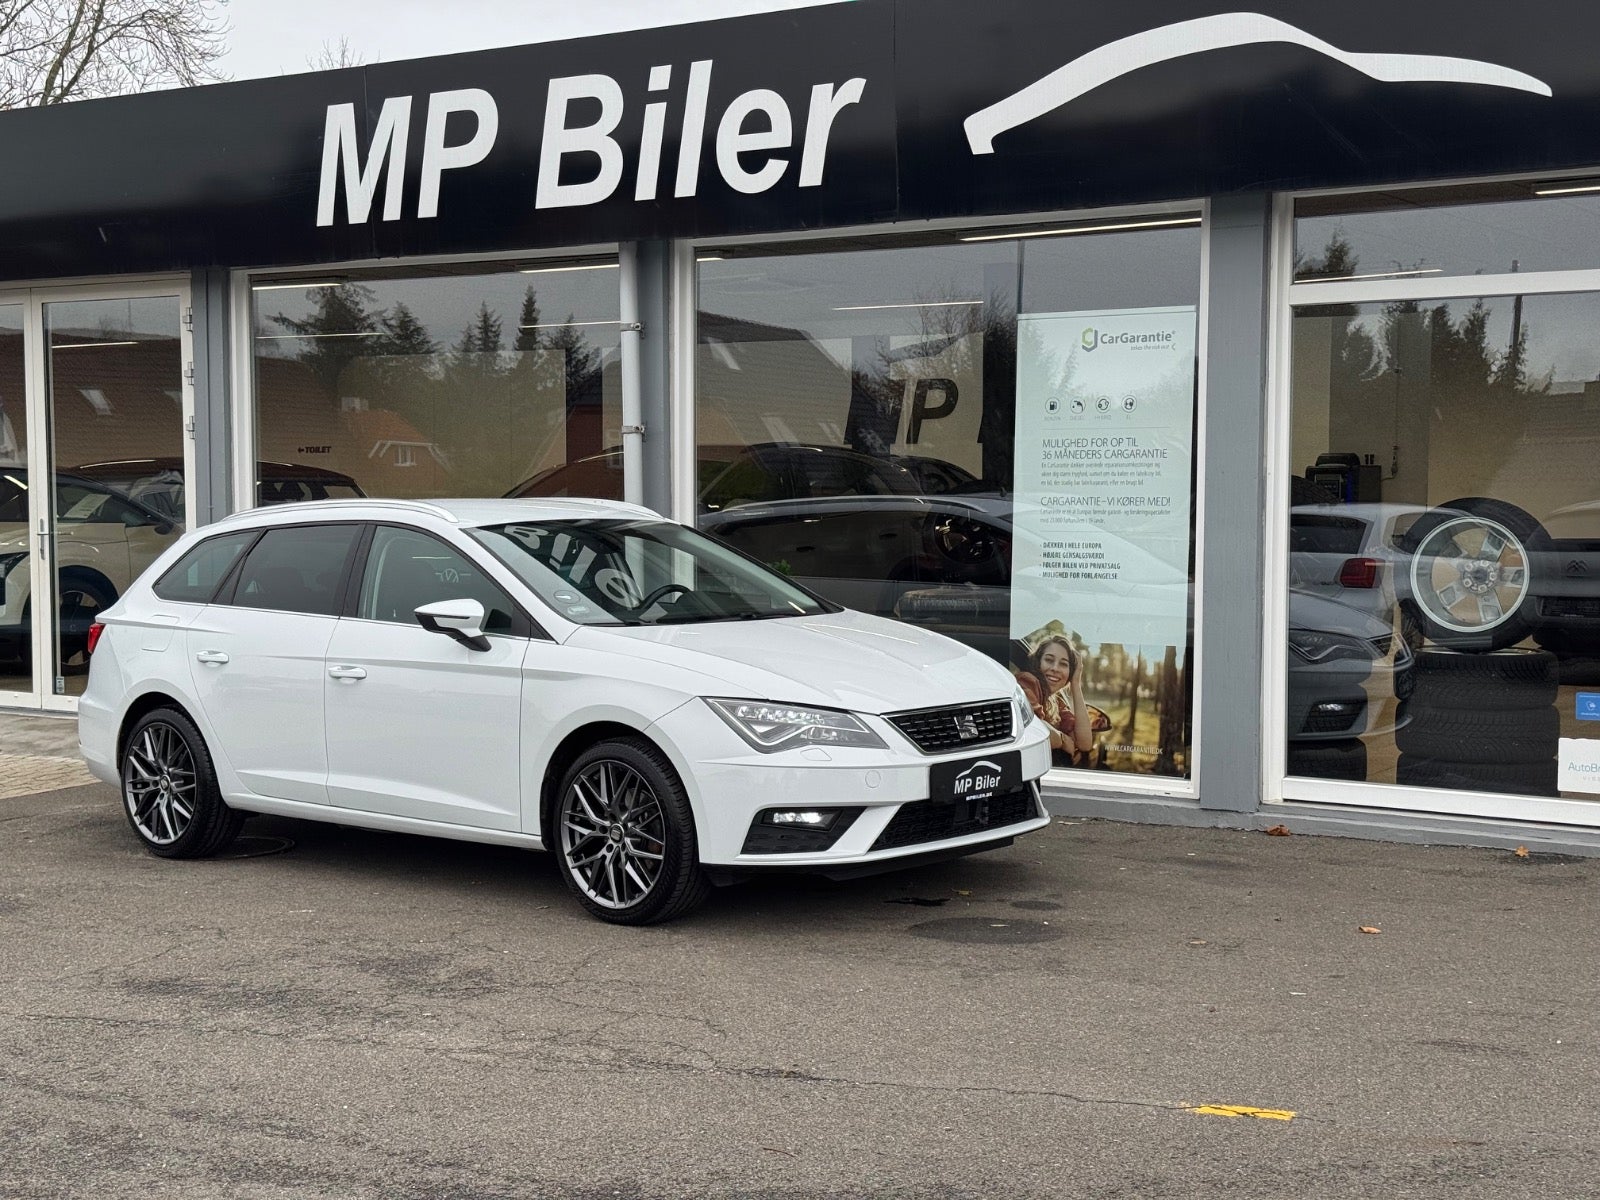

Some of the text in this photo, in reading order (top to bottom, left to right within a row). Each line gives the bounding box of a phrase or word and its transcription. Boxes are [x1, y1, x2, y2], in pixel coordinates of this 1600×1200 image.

[316, 59, 866, 227] MP Biler
[1042, 437, 1139, 448] MULIGHED FOR OP TIL
[1042, 448, 1168, 460] 36 MÅNEDERS CARGARANTIE
[1116, 496, 1146, 506] KØRER
[1147, 496, 1171, 507] MED!
[954, 774, 1001, 795] MP Biler
